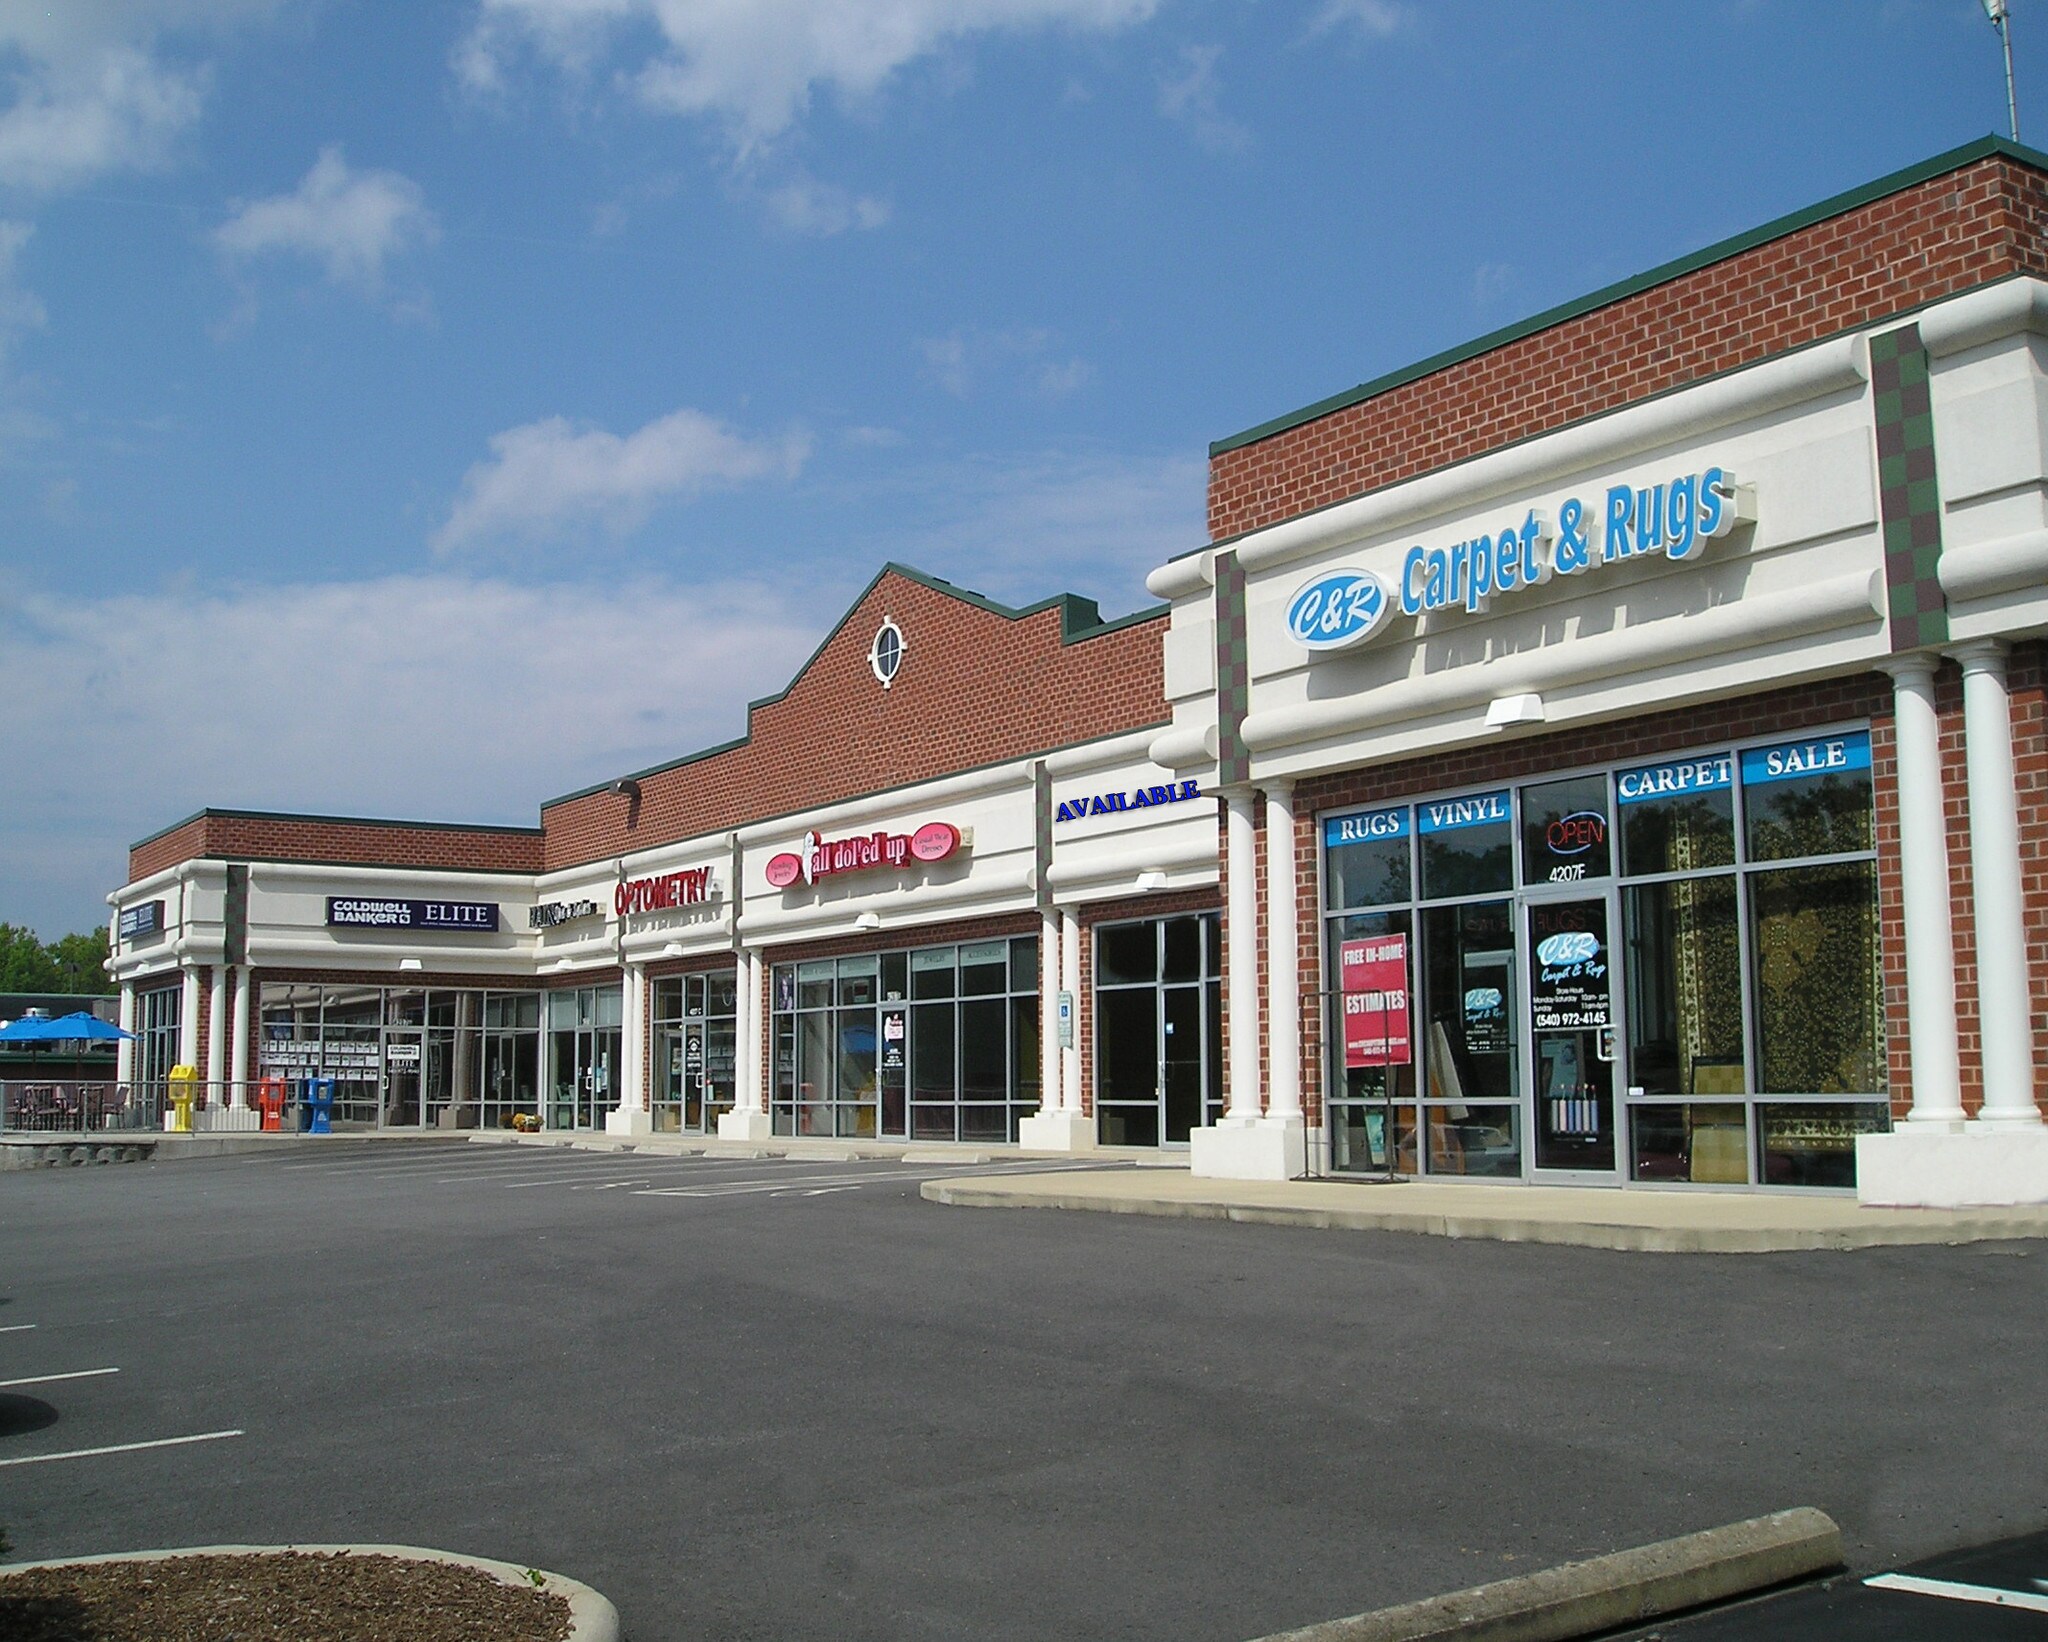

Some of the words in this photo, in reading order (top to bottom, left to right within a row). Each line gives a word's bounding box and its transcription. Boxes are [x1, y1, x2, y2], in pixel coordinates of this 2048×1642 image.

[1293, 578, 1377, 641] C&R
[1402, 508, 1546, 615] Carpet
[1556, 497, 1589, 575] &
[1603, 466, 1727, 560] Rugs
[1619, 758, 1732, 798] CARPET
[1766, 741, 1848, 776] SALE
[1340, 811, 1400, 841] RUGS
[1429, 796, 1505, 827] VINYL
[1546, 820, 1604, 846] OPEN
[811, 846, 830, 874] all
[834, 836, 880, 869] dol'ed
[886, 838, 906, 865] up
[1549, 863, 1586, 882] 4207F
[615, 866, 711, 917] OPTOMETRY
[333, 900, 412, 914] COLDWELL
[333, 911, 398, 925] BANKER
[425, 904, 488, 923] ELITE
[1344, 949, 1365, 966] FREE
[1366, 943, 1404, 963] IN-HOME
[1540, 932, 1595, 966] C&R
[1346, 989, 1405, 1015] ESTIMATES
[1536, 1013, 1560, 1027] (540)
[1561, 1011, 1607, 1026] 972-4145
